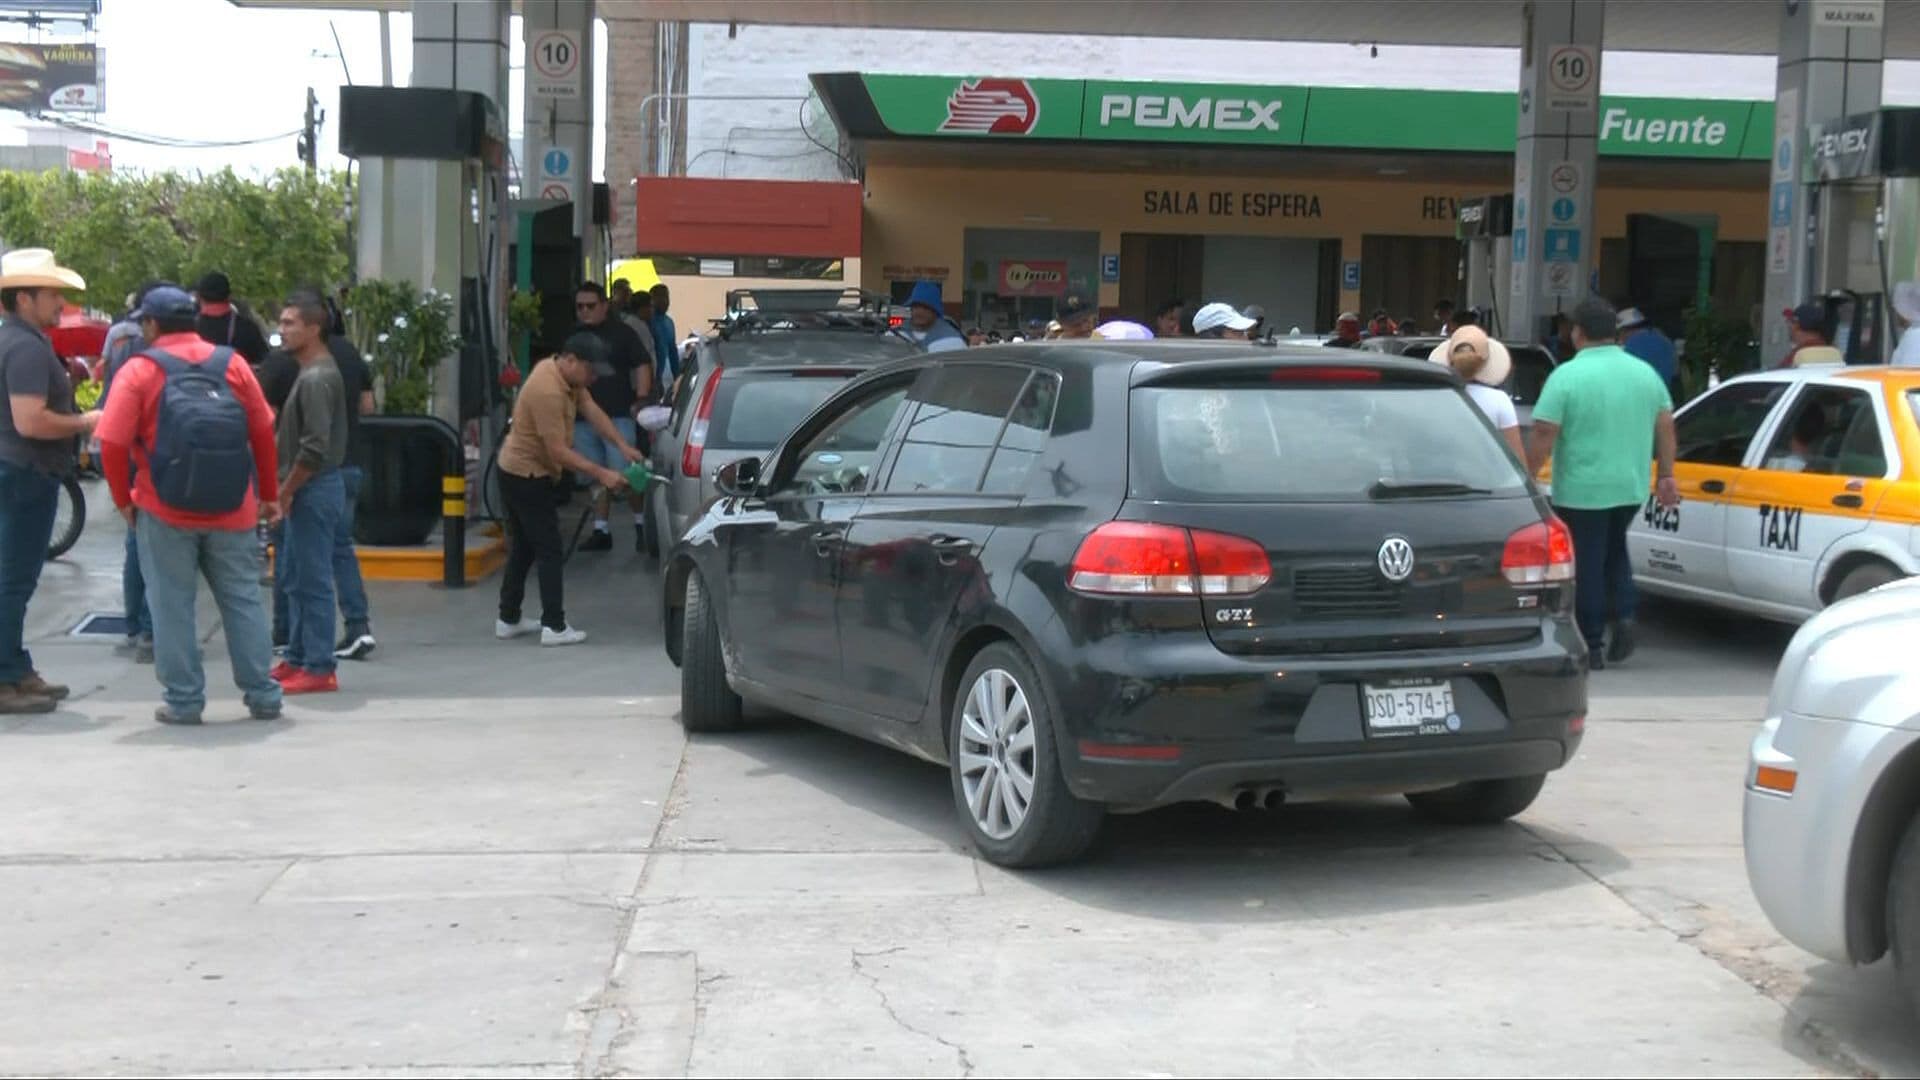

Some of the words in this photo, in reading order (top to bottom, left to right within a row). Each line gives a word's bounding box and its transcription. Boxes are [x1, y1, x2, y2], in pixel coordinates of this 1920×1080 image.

[543, 42, 569, 65] 10
[1557, 57, 1584, 78] 10
[1100, 94, 1283, 132] PEMEX
[1600, 108, 1726, 145] Fuente
[1144, 190, 1198, 215] SALA
[1208, 191, 1233, 216] DE
[1242, 192, 1322, 218] ESPERA
[1104, 255, 1117, 275] E
[1345, 263, 1357, 282] E
[1759, 504, 1803, 551] TAXI
